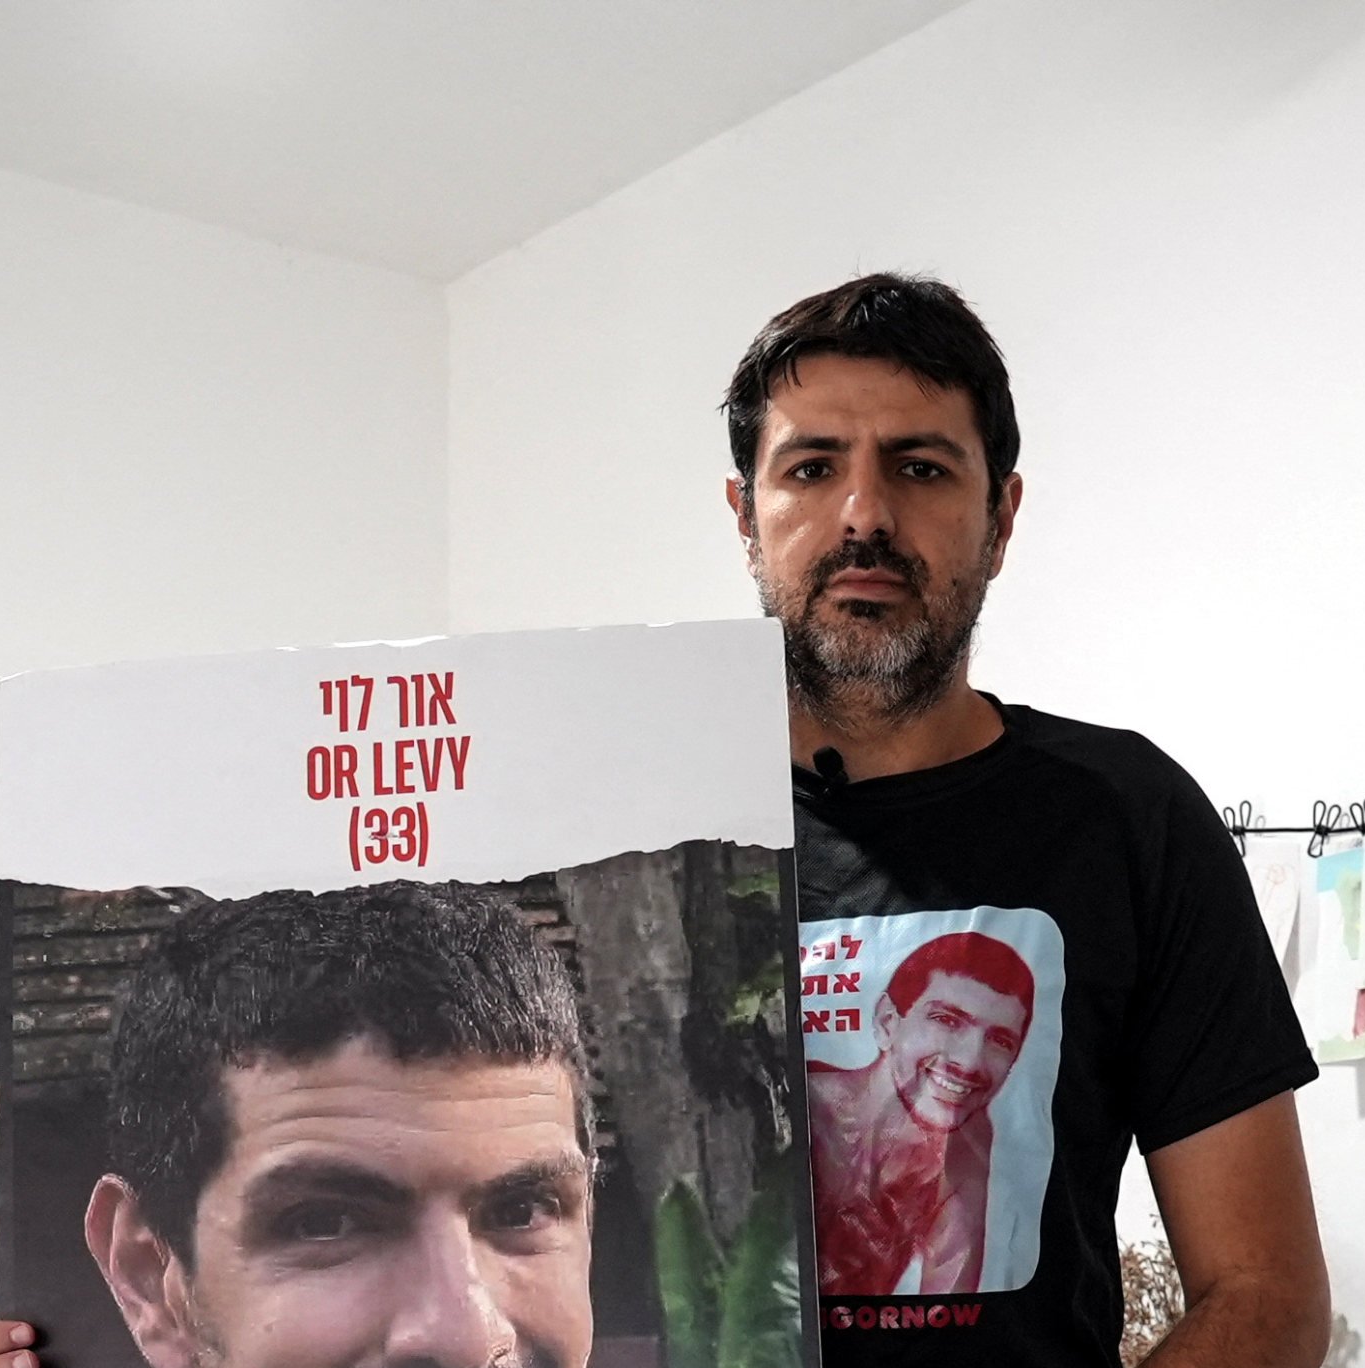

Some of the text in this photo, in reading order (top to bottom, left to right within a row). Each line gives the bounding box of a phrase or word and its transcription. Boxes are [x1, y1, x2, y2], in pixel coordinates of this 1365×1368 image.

[319, 672, 456, 732] אור לוי
[307, 736, 471, 800] OR LEVY
[349, 802, 429, 871] (33)
[800, 934, 863, 962] לה
[801, 972, 861, 996] את
[803, 1008, 861, 1033] הא
